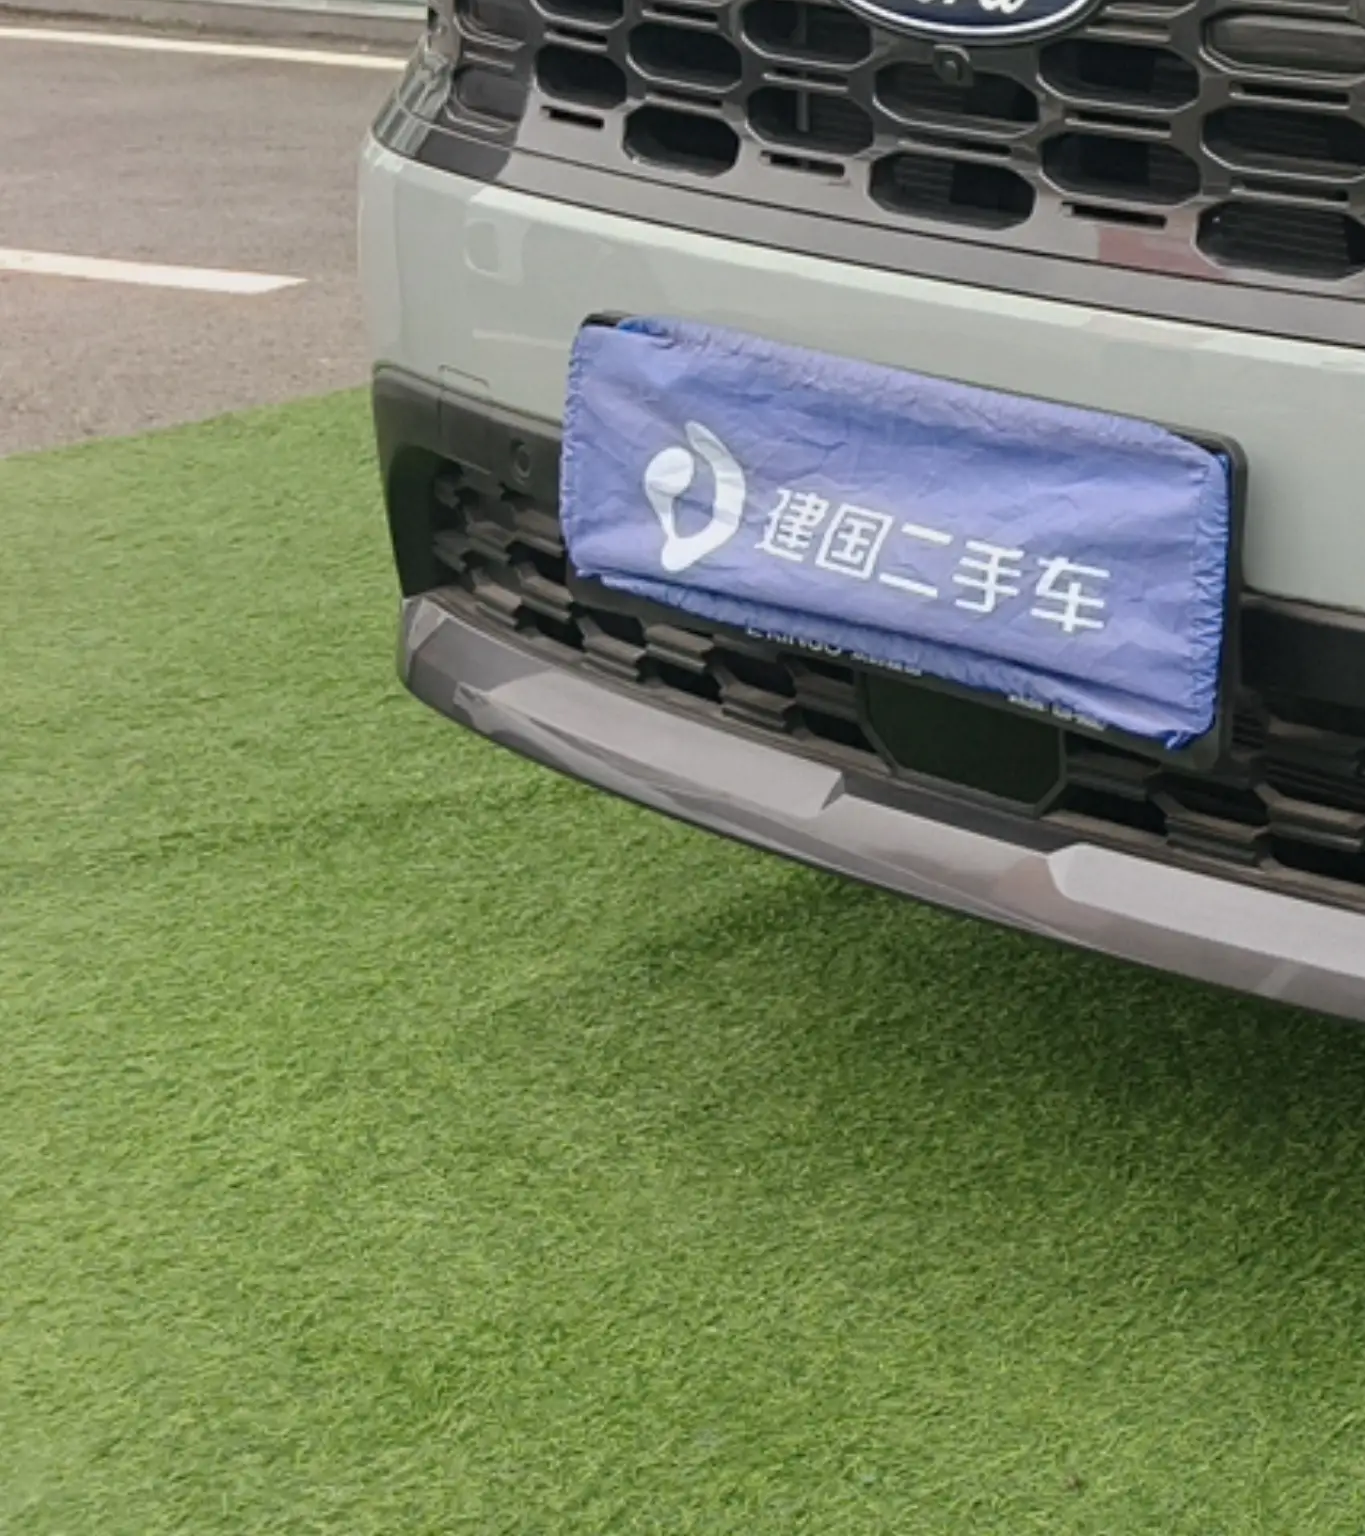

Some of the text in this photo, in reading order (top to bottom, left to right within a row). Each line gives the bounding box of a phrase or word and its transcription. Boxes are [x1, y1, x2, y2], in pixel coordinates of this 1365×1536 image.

[754, 488, 1111, 632] 建国二手车
